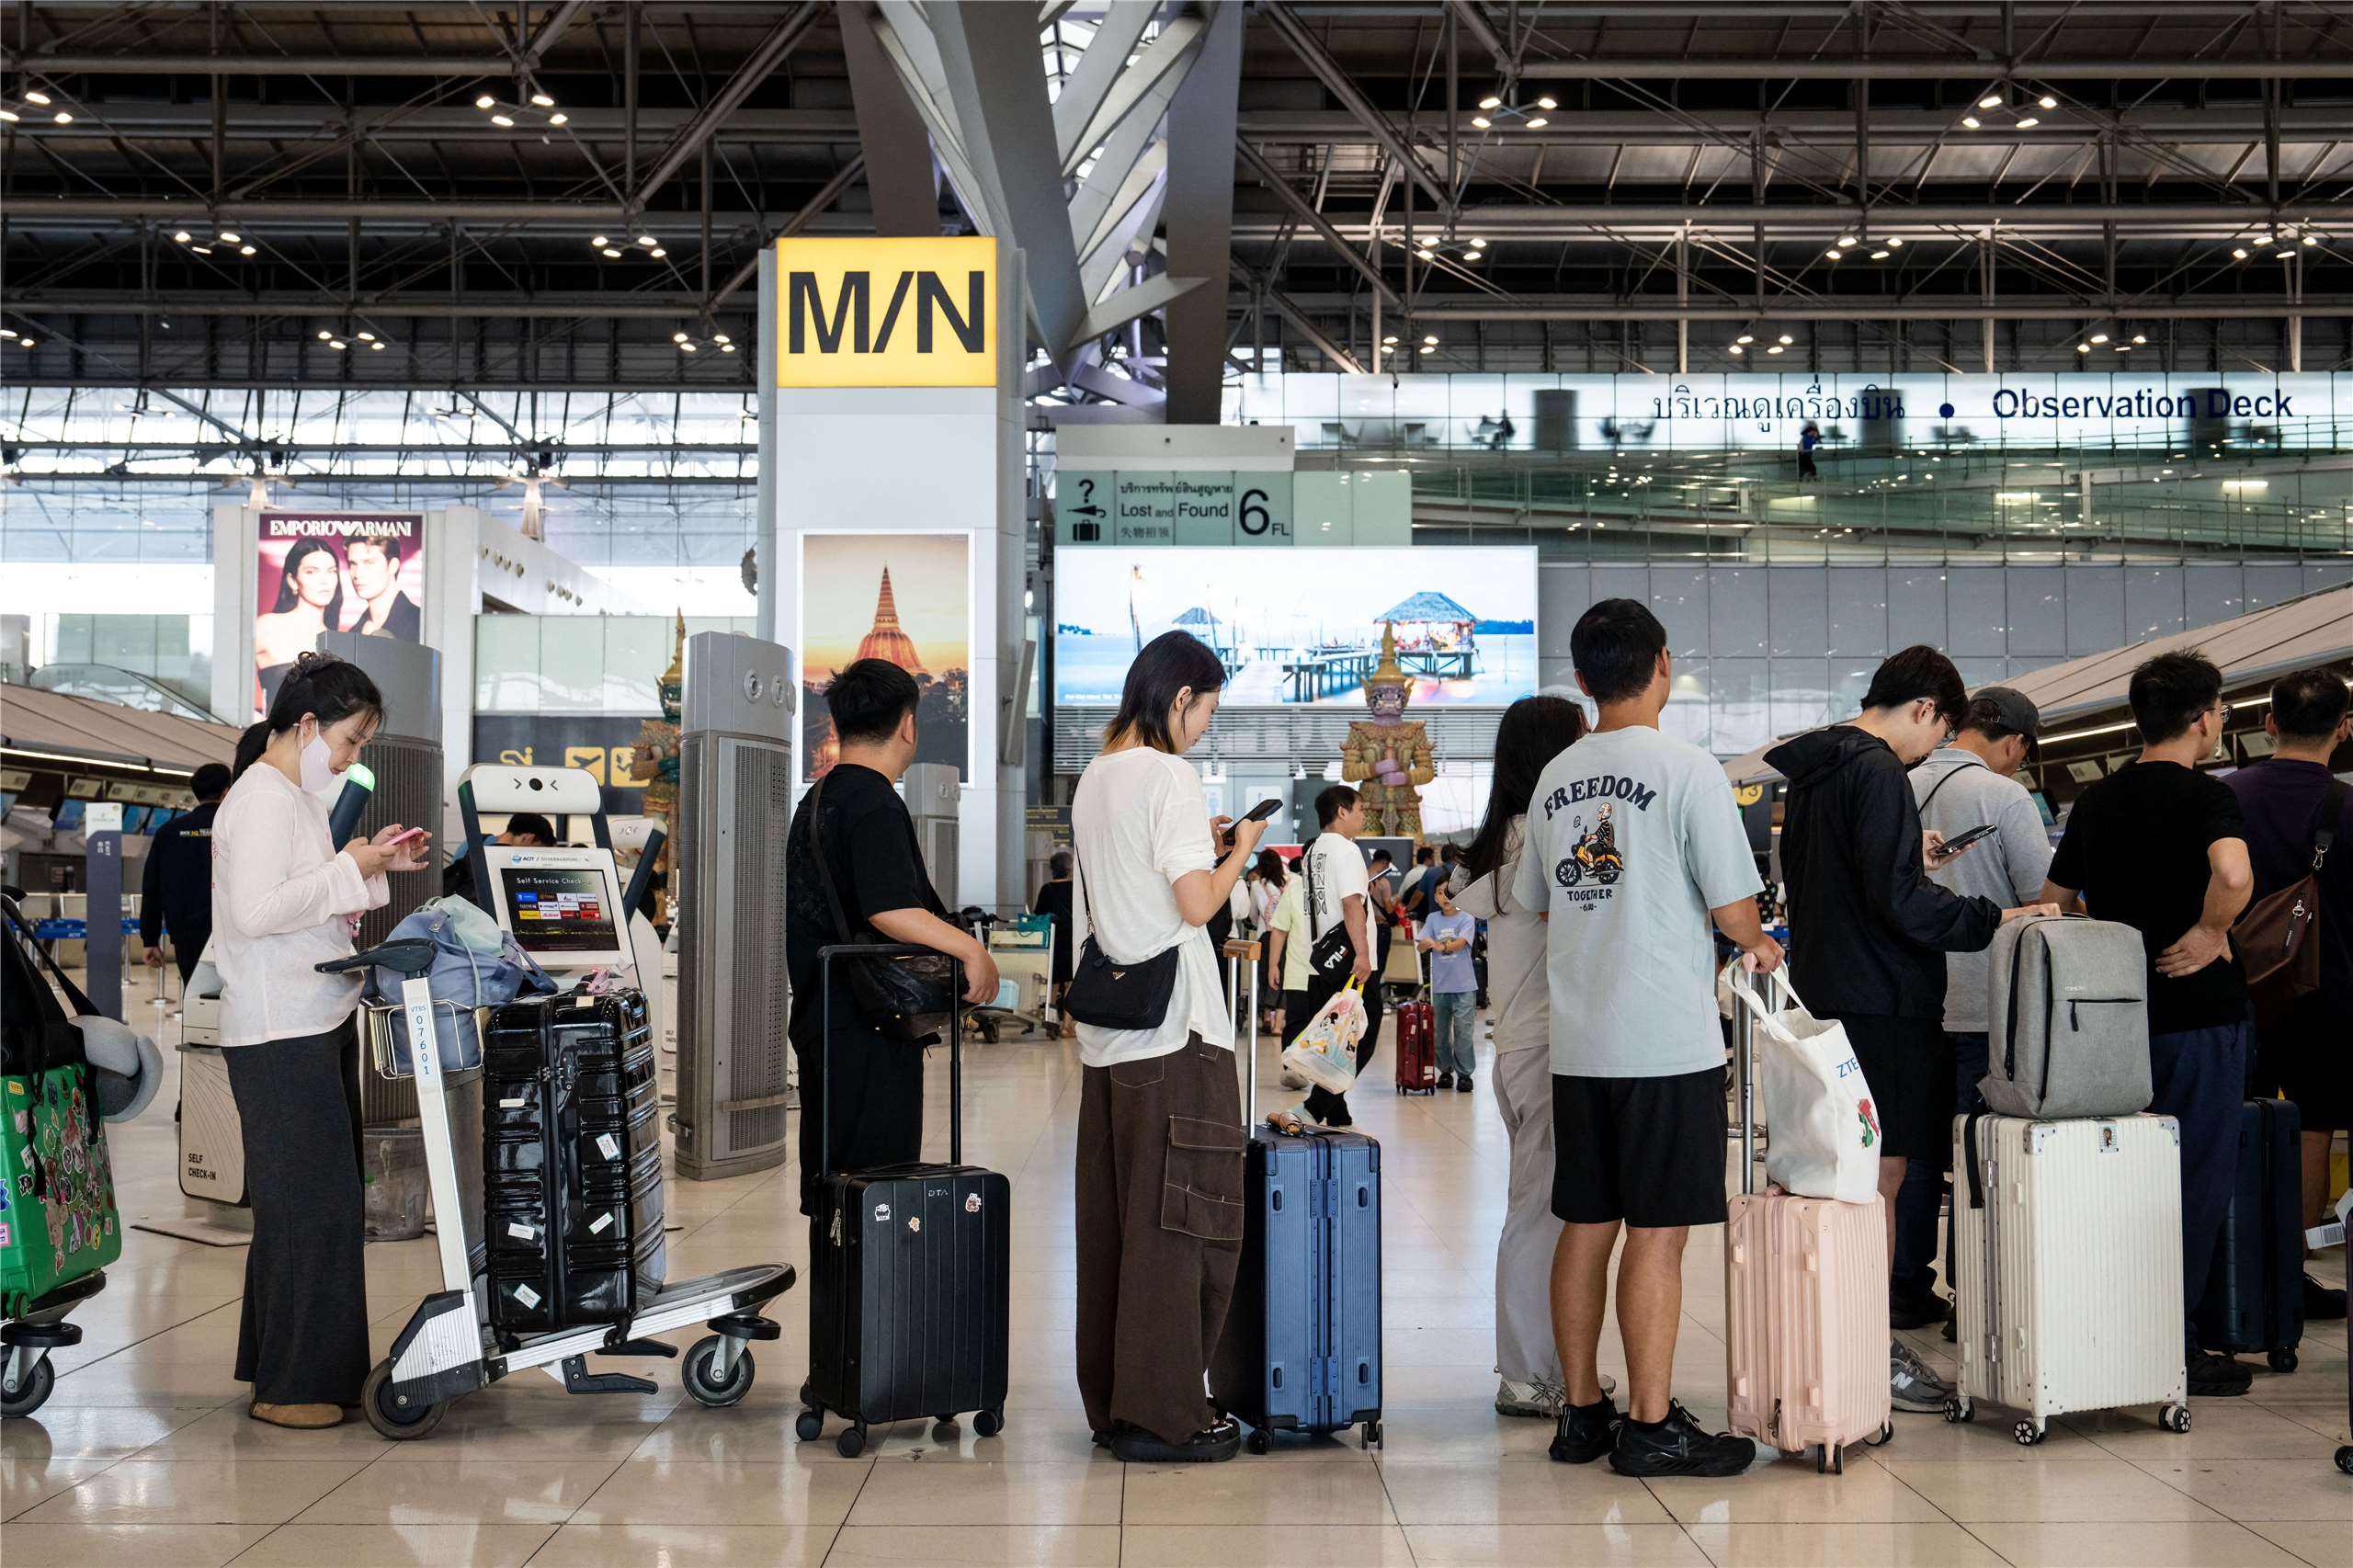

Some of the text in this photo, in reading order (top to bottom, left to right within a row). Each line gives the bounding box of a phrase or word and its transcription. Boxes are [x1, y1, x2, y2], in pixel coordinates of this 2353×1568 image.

[789, 271, 985, 353] M/N
[1654, 374, 1905, 433] บริเวณดูเครื่องบิน
[1993, 387, 2294, 418] Observation Deck
[1120, 503, 1228, 517] Lost and Found
[1239, 488, 1290, 536] 6 FL
[269, 519, 412, 537] EMPORIO ARMANI
[1543, 775, 1657, 821] FREEDOM
[1566, 889, 1613, 902] TOGETHER
[1324, 945, 1348, 970] FILA
[1836, 1057, 1859, 1078] ZTE
[188, 1153, 203, 1164] SELF
[188, 1167, 216, 1181] CHECK-IN
